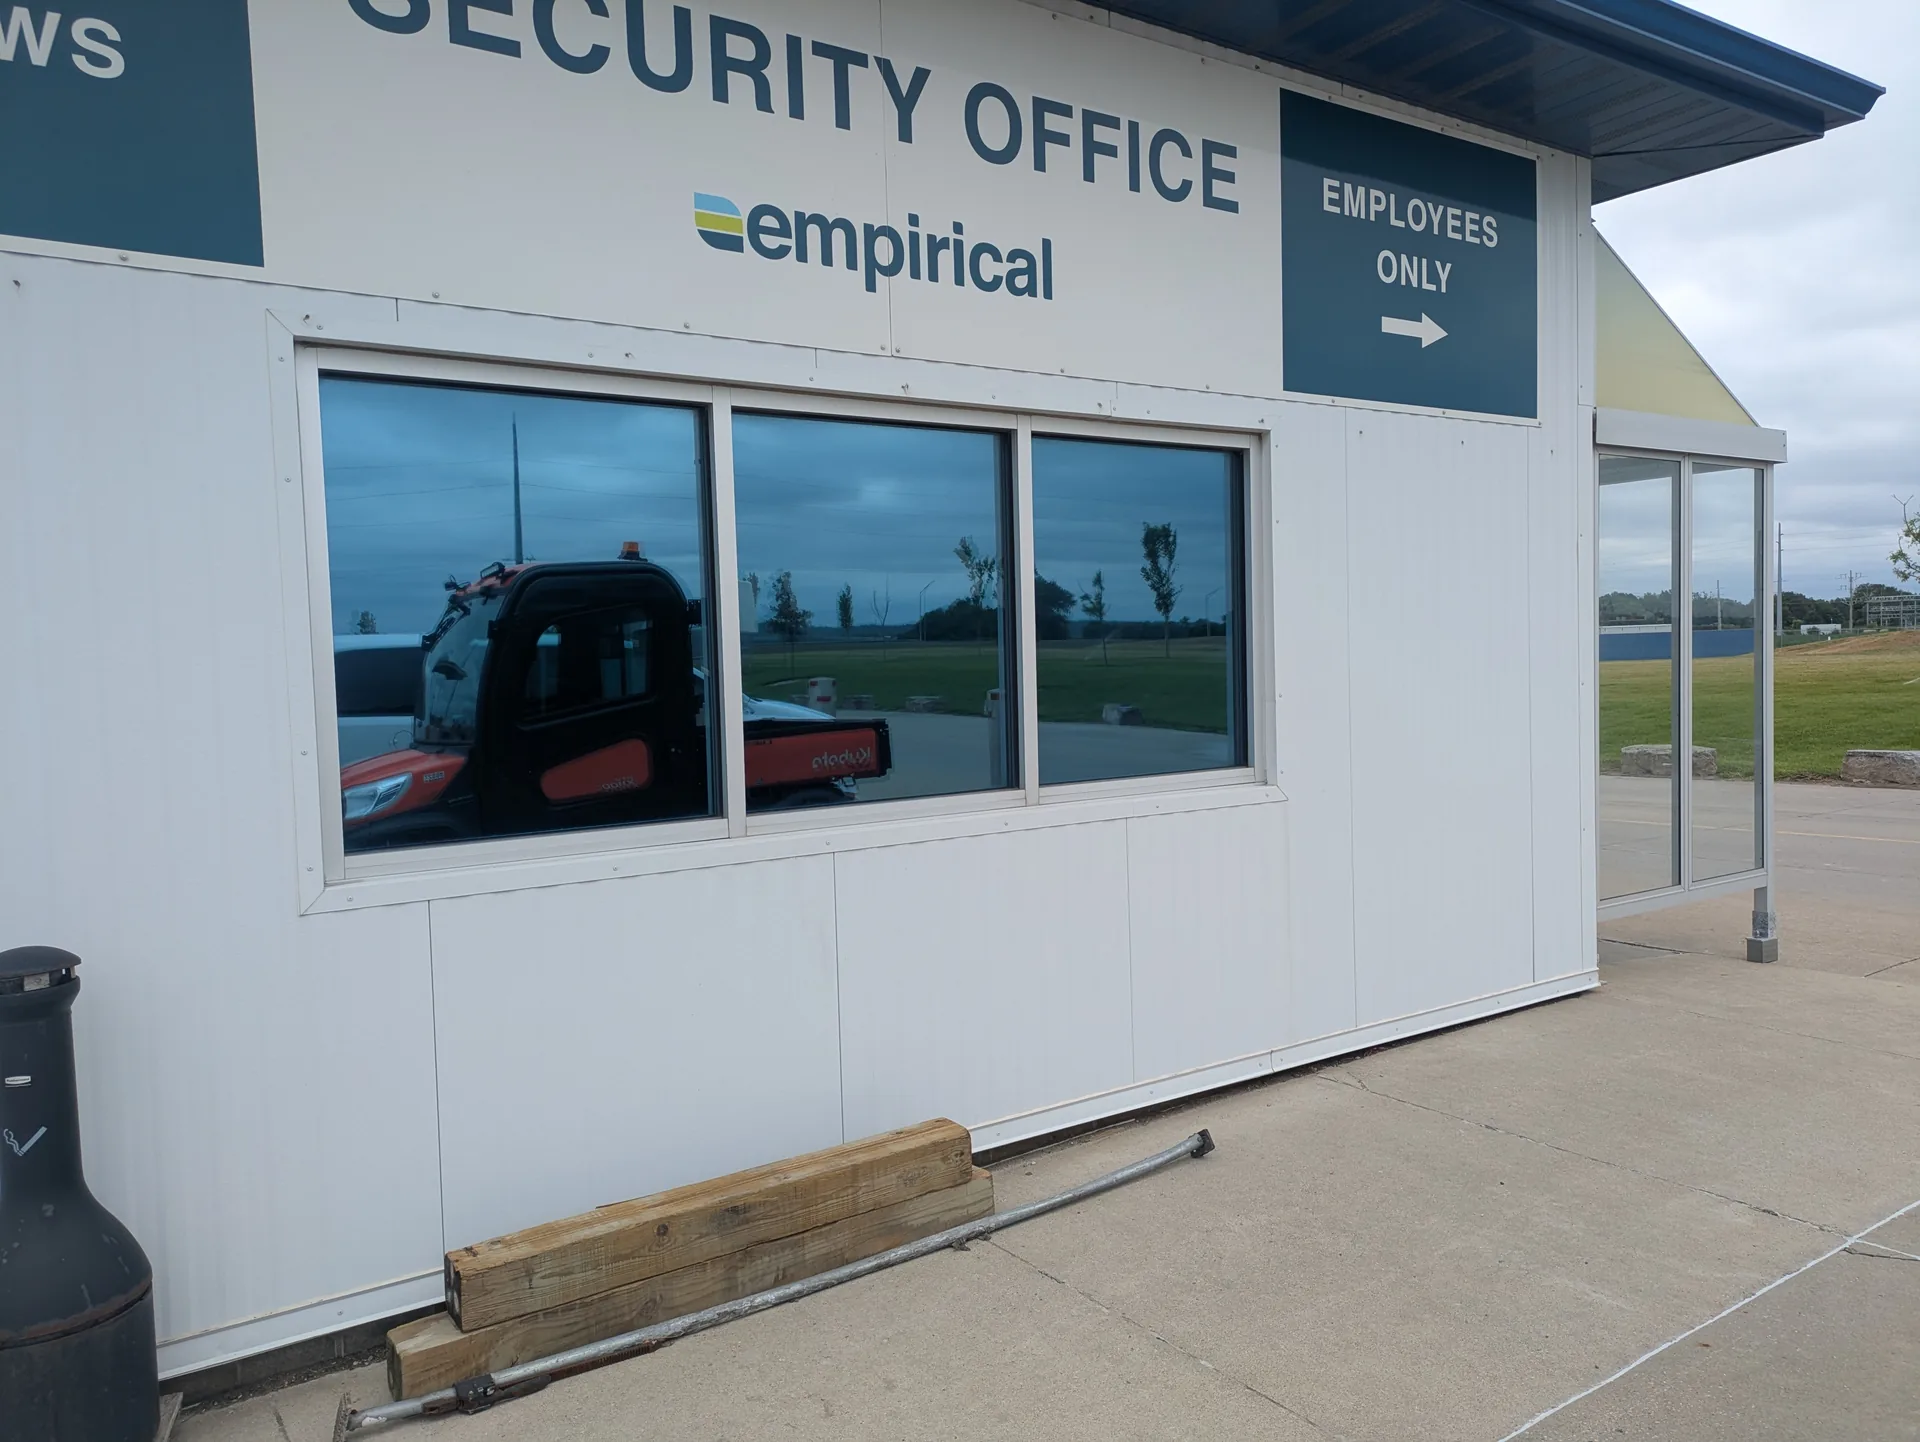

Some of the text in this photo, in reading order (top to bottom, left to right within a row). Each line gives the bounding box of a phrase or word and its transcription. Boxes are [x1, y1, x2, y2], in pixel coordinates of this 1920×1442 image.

[964, 82, 1239, 214] OFFICE
[746, 203, 1053, 301] empirical
[1323, 177, 1498, 248] EMPLOYEES
[1377, 249, 1452, 293] ONLY
